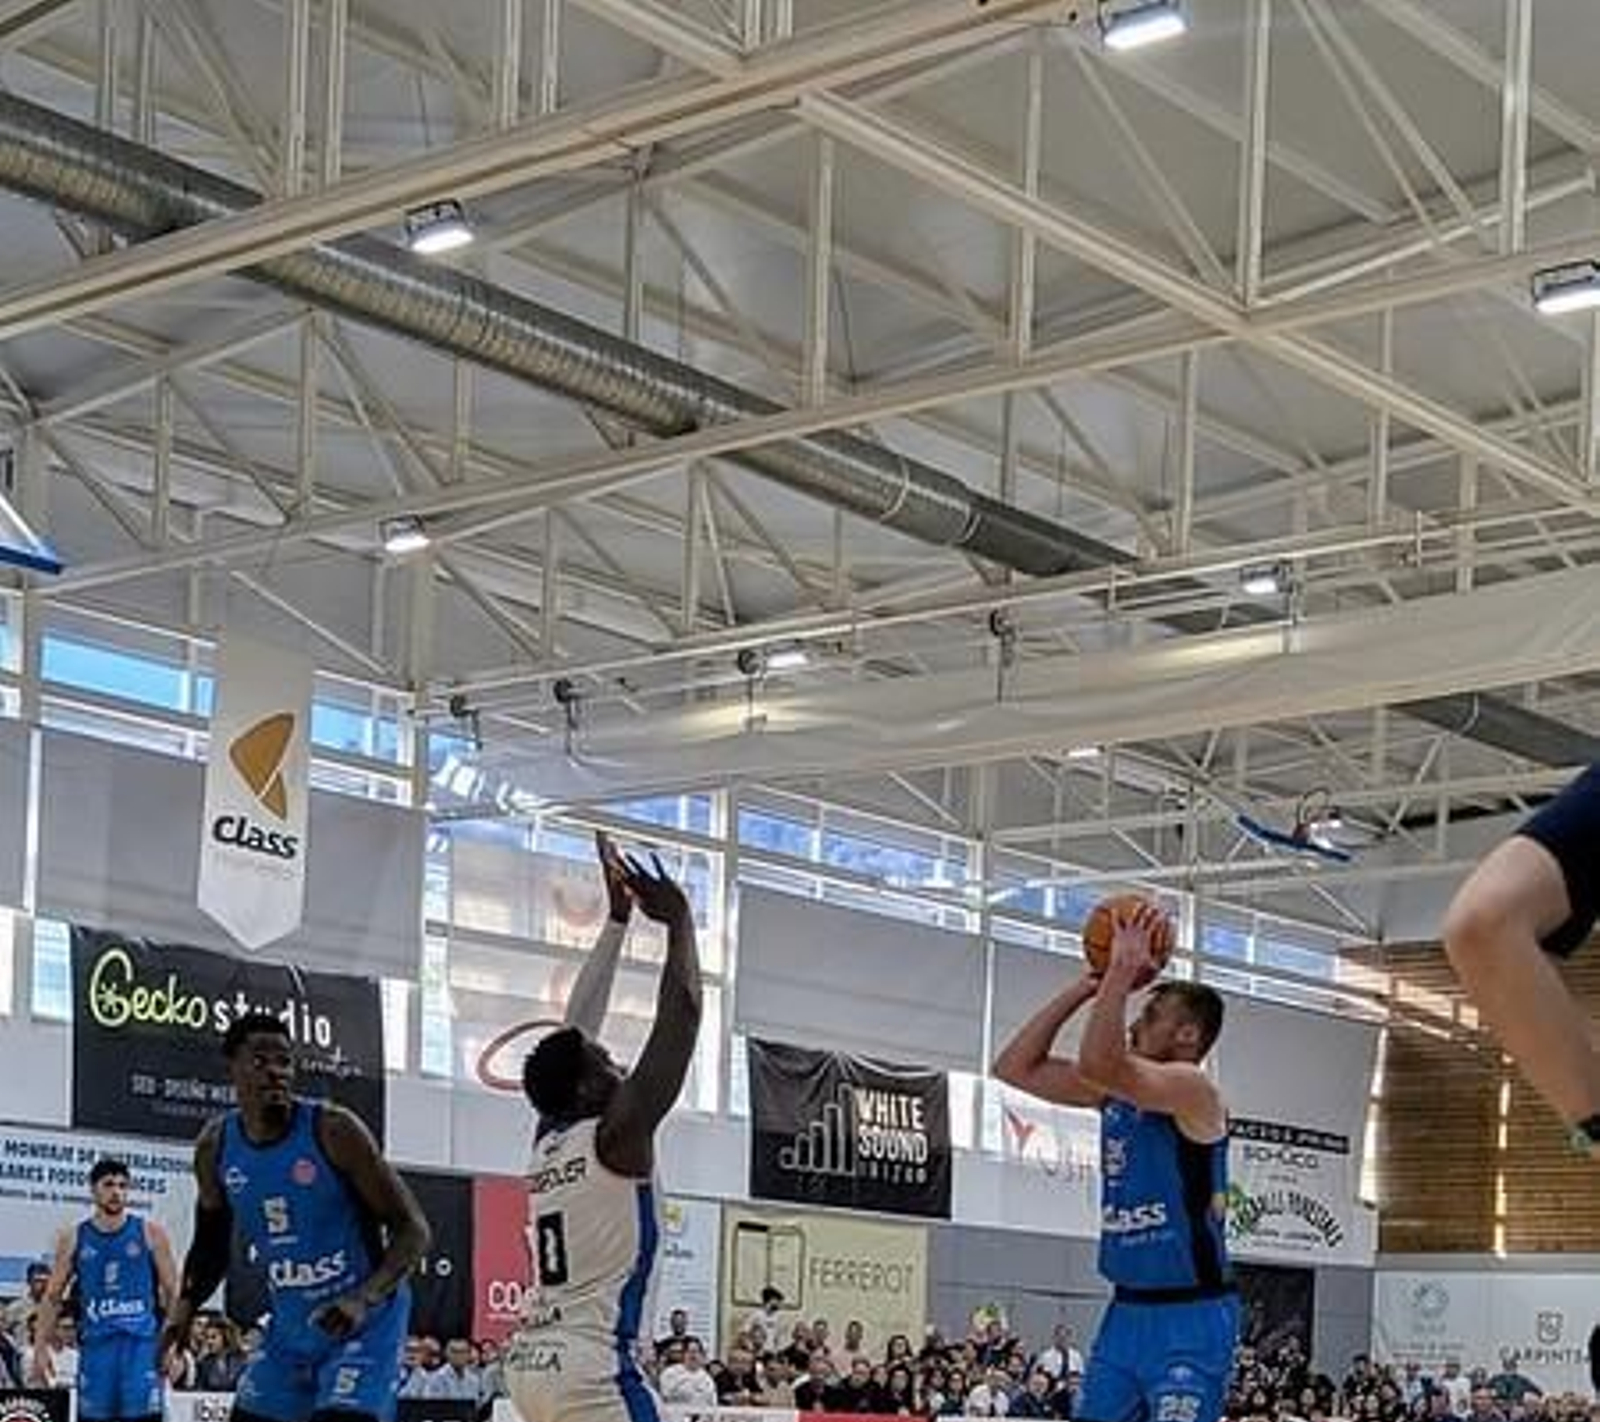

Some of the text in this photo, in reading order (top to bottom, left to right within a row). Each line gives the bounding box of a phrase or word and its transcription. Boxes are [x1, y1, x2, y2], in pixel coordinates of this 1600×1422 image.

[89, 948, 207, 1027] Gecko
[854, 1087, 924, 1130] WHITE
[858, 1124, 929, 1165] SOUND
[265, 1197, 288, 1233] 5
